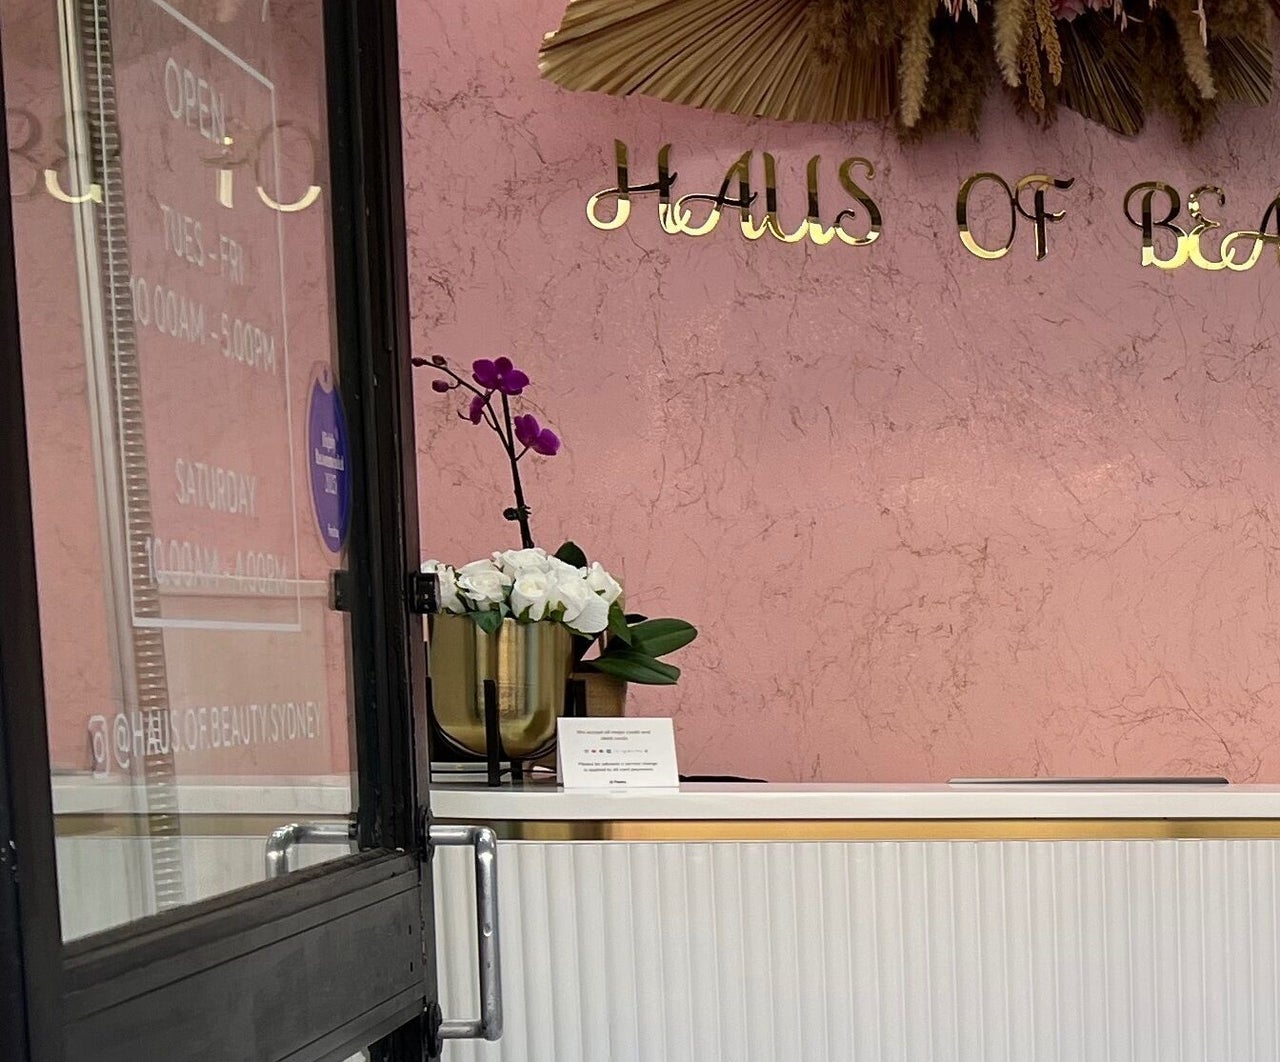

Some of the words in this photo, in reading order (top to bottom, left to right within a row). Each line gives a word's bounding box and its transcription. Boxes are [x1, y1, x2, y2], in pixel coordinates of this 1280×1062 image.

[164, 56, 227, 145] OPEN
[585, 137, 884, 248] HAUS
[957, 171, 1075, 263] OF
[160, 203, 205, 267] TUES
[220, 233, 244, 286] FRI
[175, 456, 259, 518] SATURDAY
